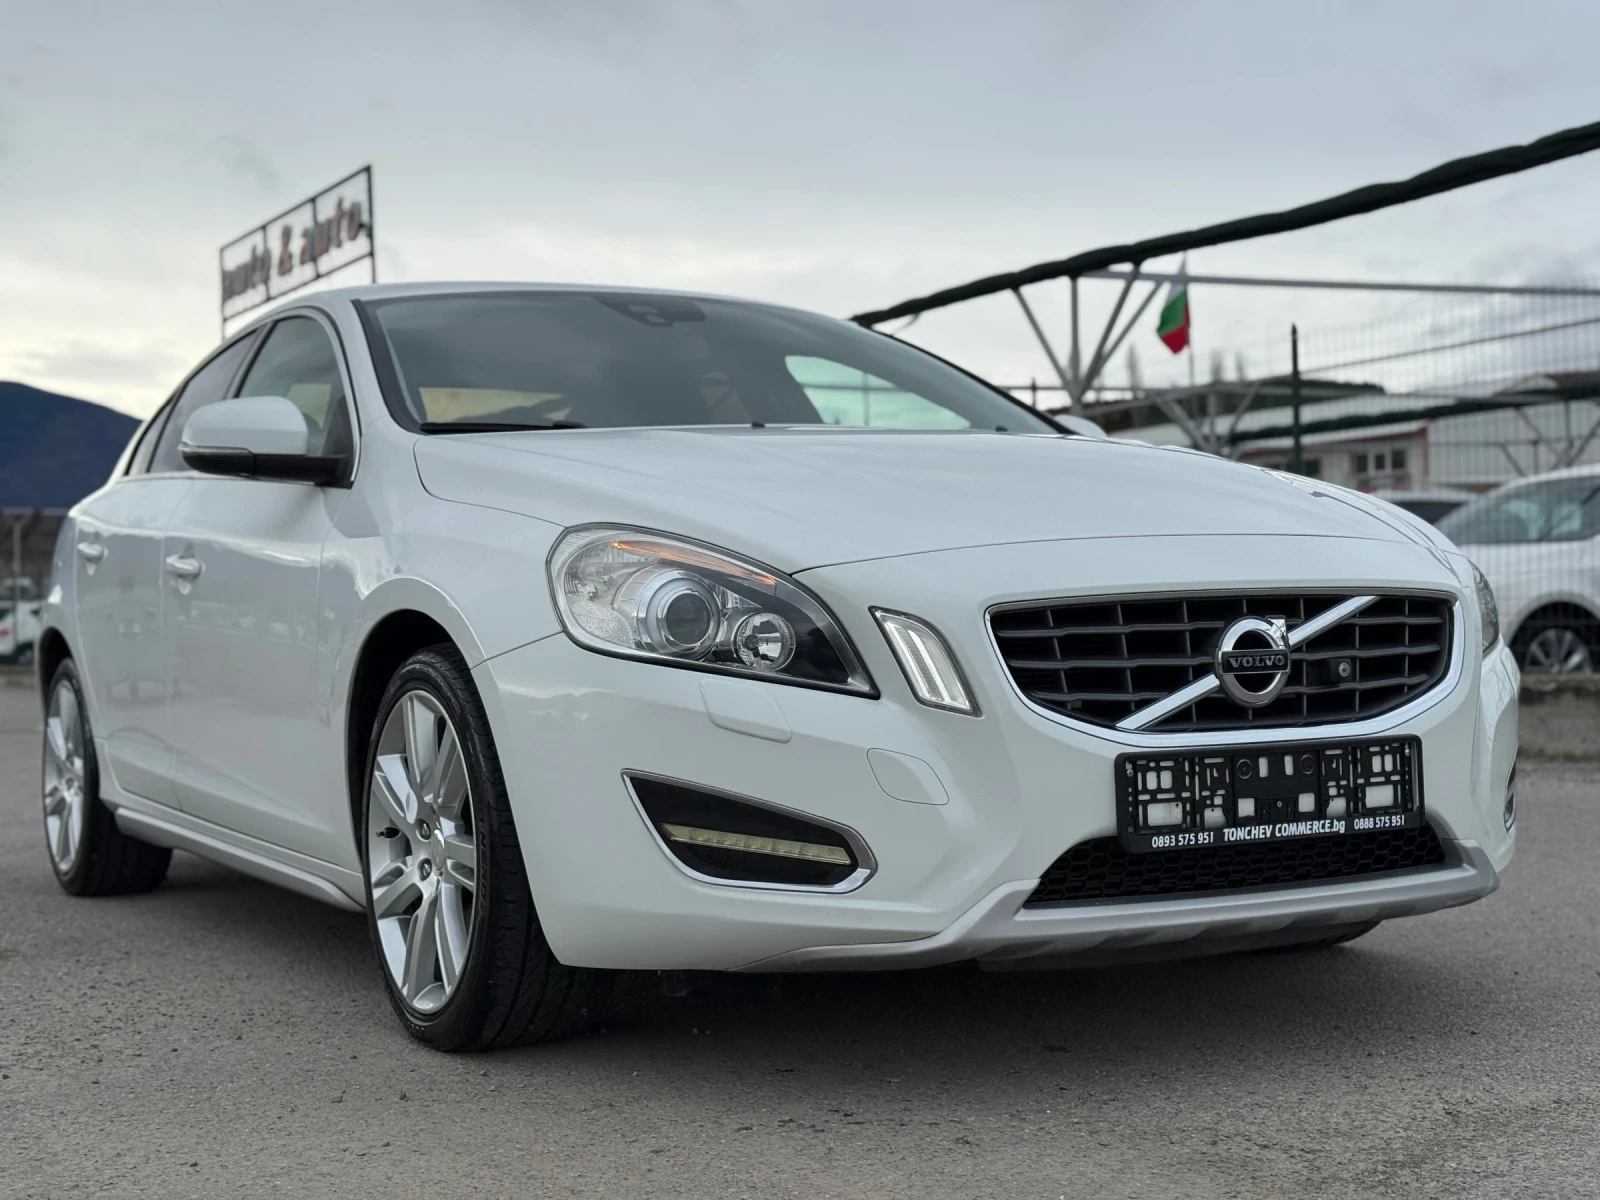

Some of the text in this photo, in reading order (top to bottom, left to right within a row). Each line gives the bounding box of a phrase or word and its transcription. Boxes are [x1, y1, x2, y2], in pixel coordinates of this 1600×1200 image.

[1227, 655, 1285, 668] VOLVO
[1151, 815, 1405, 848] 0893 575 951 TONCHEV COMMERCE.bg 0888 575 951
